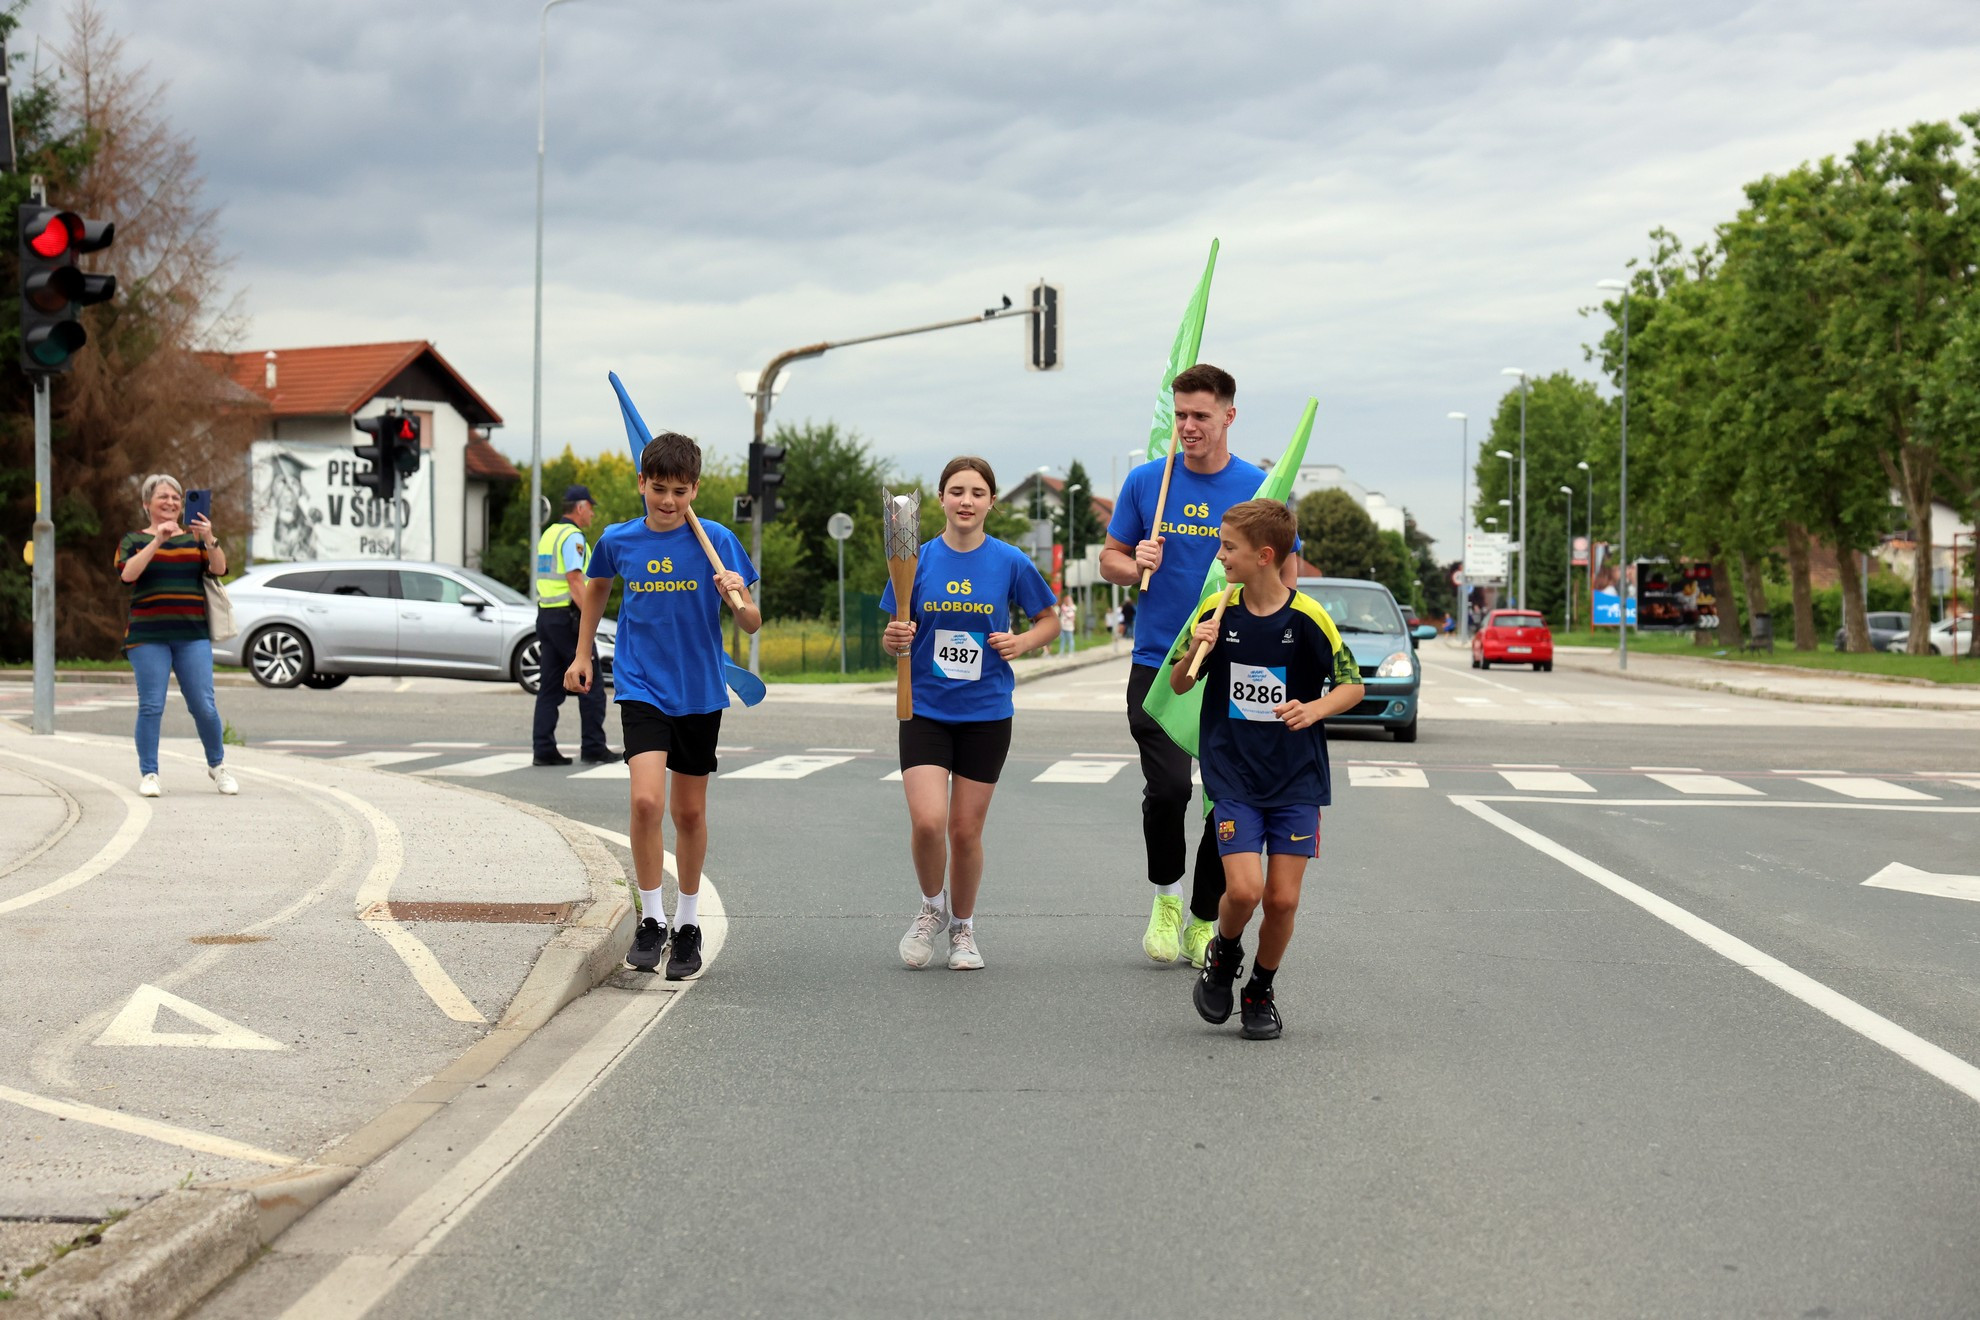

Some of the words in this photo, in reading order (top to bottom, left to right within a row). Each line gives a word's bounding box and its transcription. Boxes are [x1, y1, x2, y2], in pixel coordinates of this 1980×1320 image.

[327, 494, 344, 526] V
[1184, 503, 1209, 518] OŠ
[1160, 522, 1221, 538] GLOBOK
[646, 556, 674, 574] OŠ
[628, 579, 698, 593] GLOBOKO
[946, 578, 973, 595] OŠ
[923, 601, 994, 615] GLOBOKO
[938, 646, 979, 665] 4387
[1233, 682, 1282, 703] 8286
